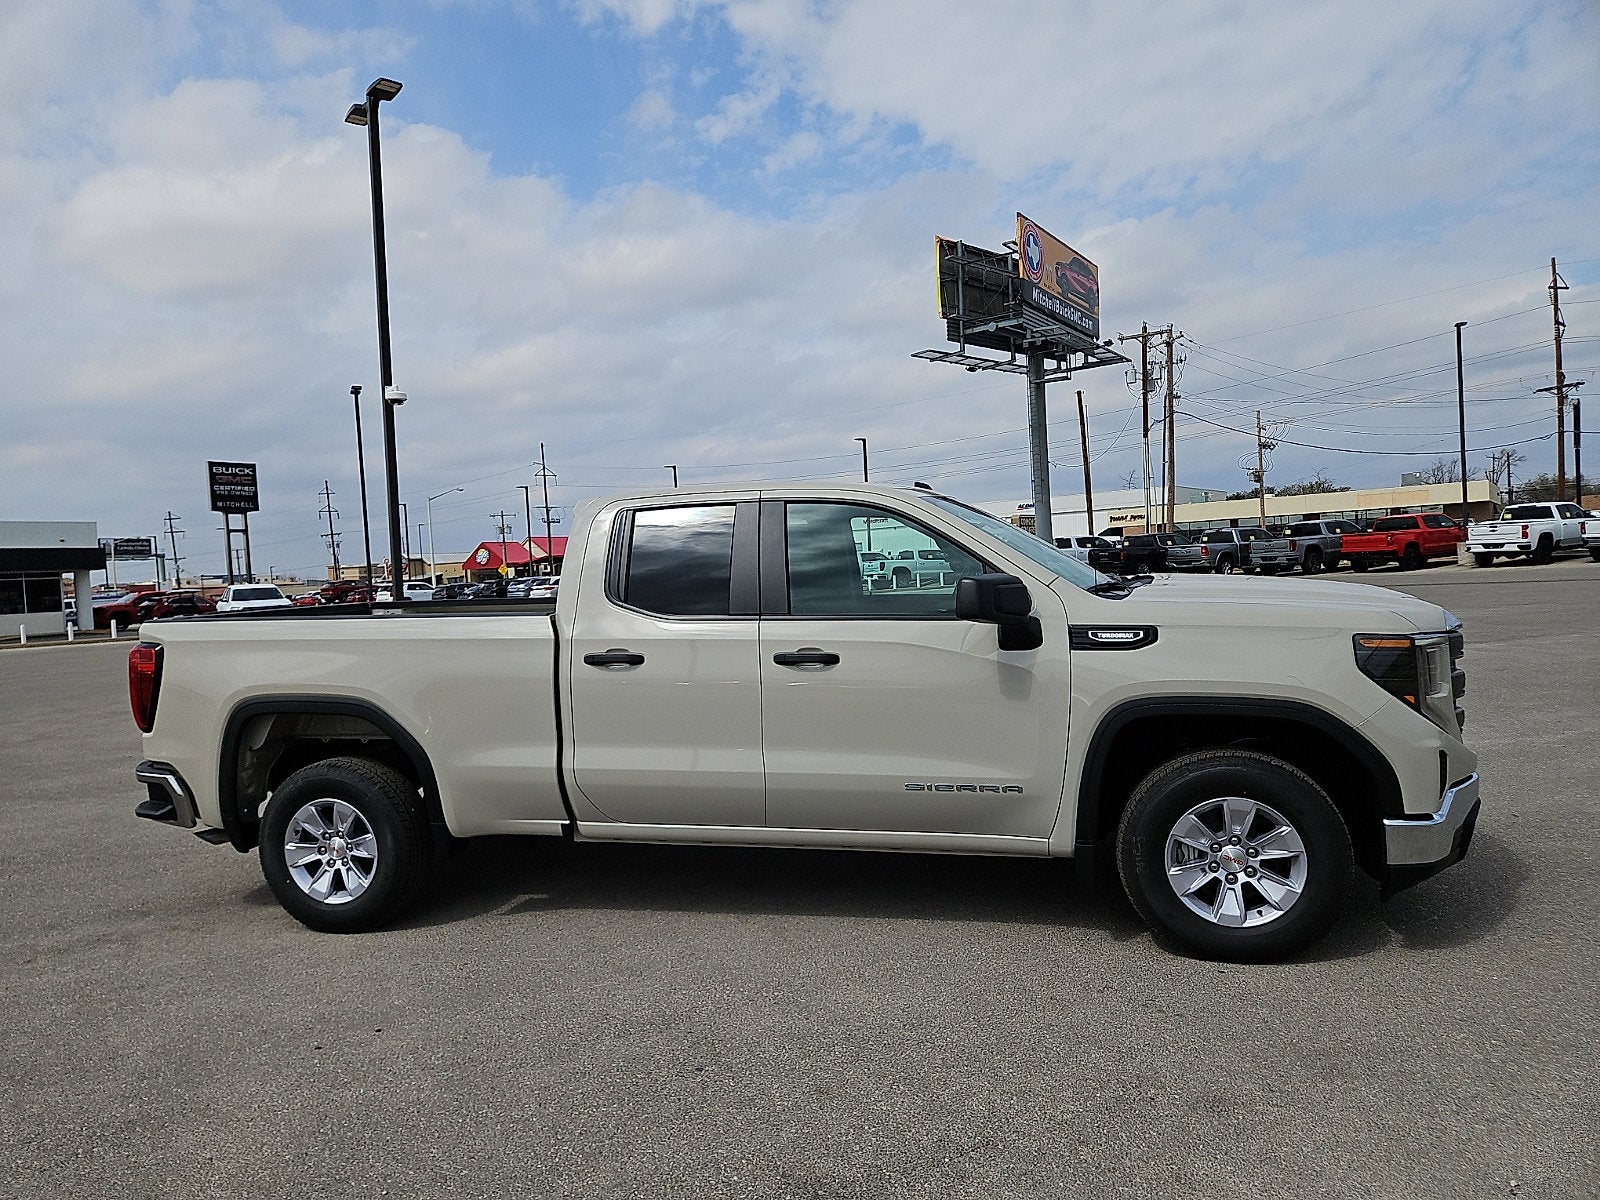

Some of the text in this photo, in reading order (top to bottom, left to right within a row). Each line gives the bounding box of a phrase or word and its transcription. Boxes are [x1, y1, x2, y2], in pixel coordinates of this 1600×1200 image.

[1032, 286, 1094, 331] MitchellBuickGMC.com
[212, 466, 254, 475] BUICK
[216, 475, 253, 484] GMC
[904, 782, 1024, 794] SIERRA
[1222, 854, 1244, 867] GMC
